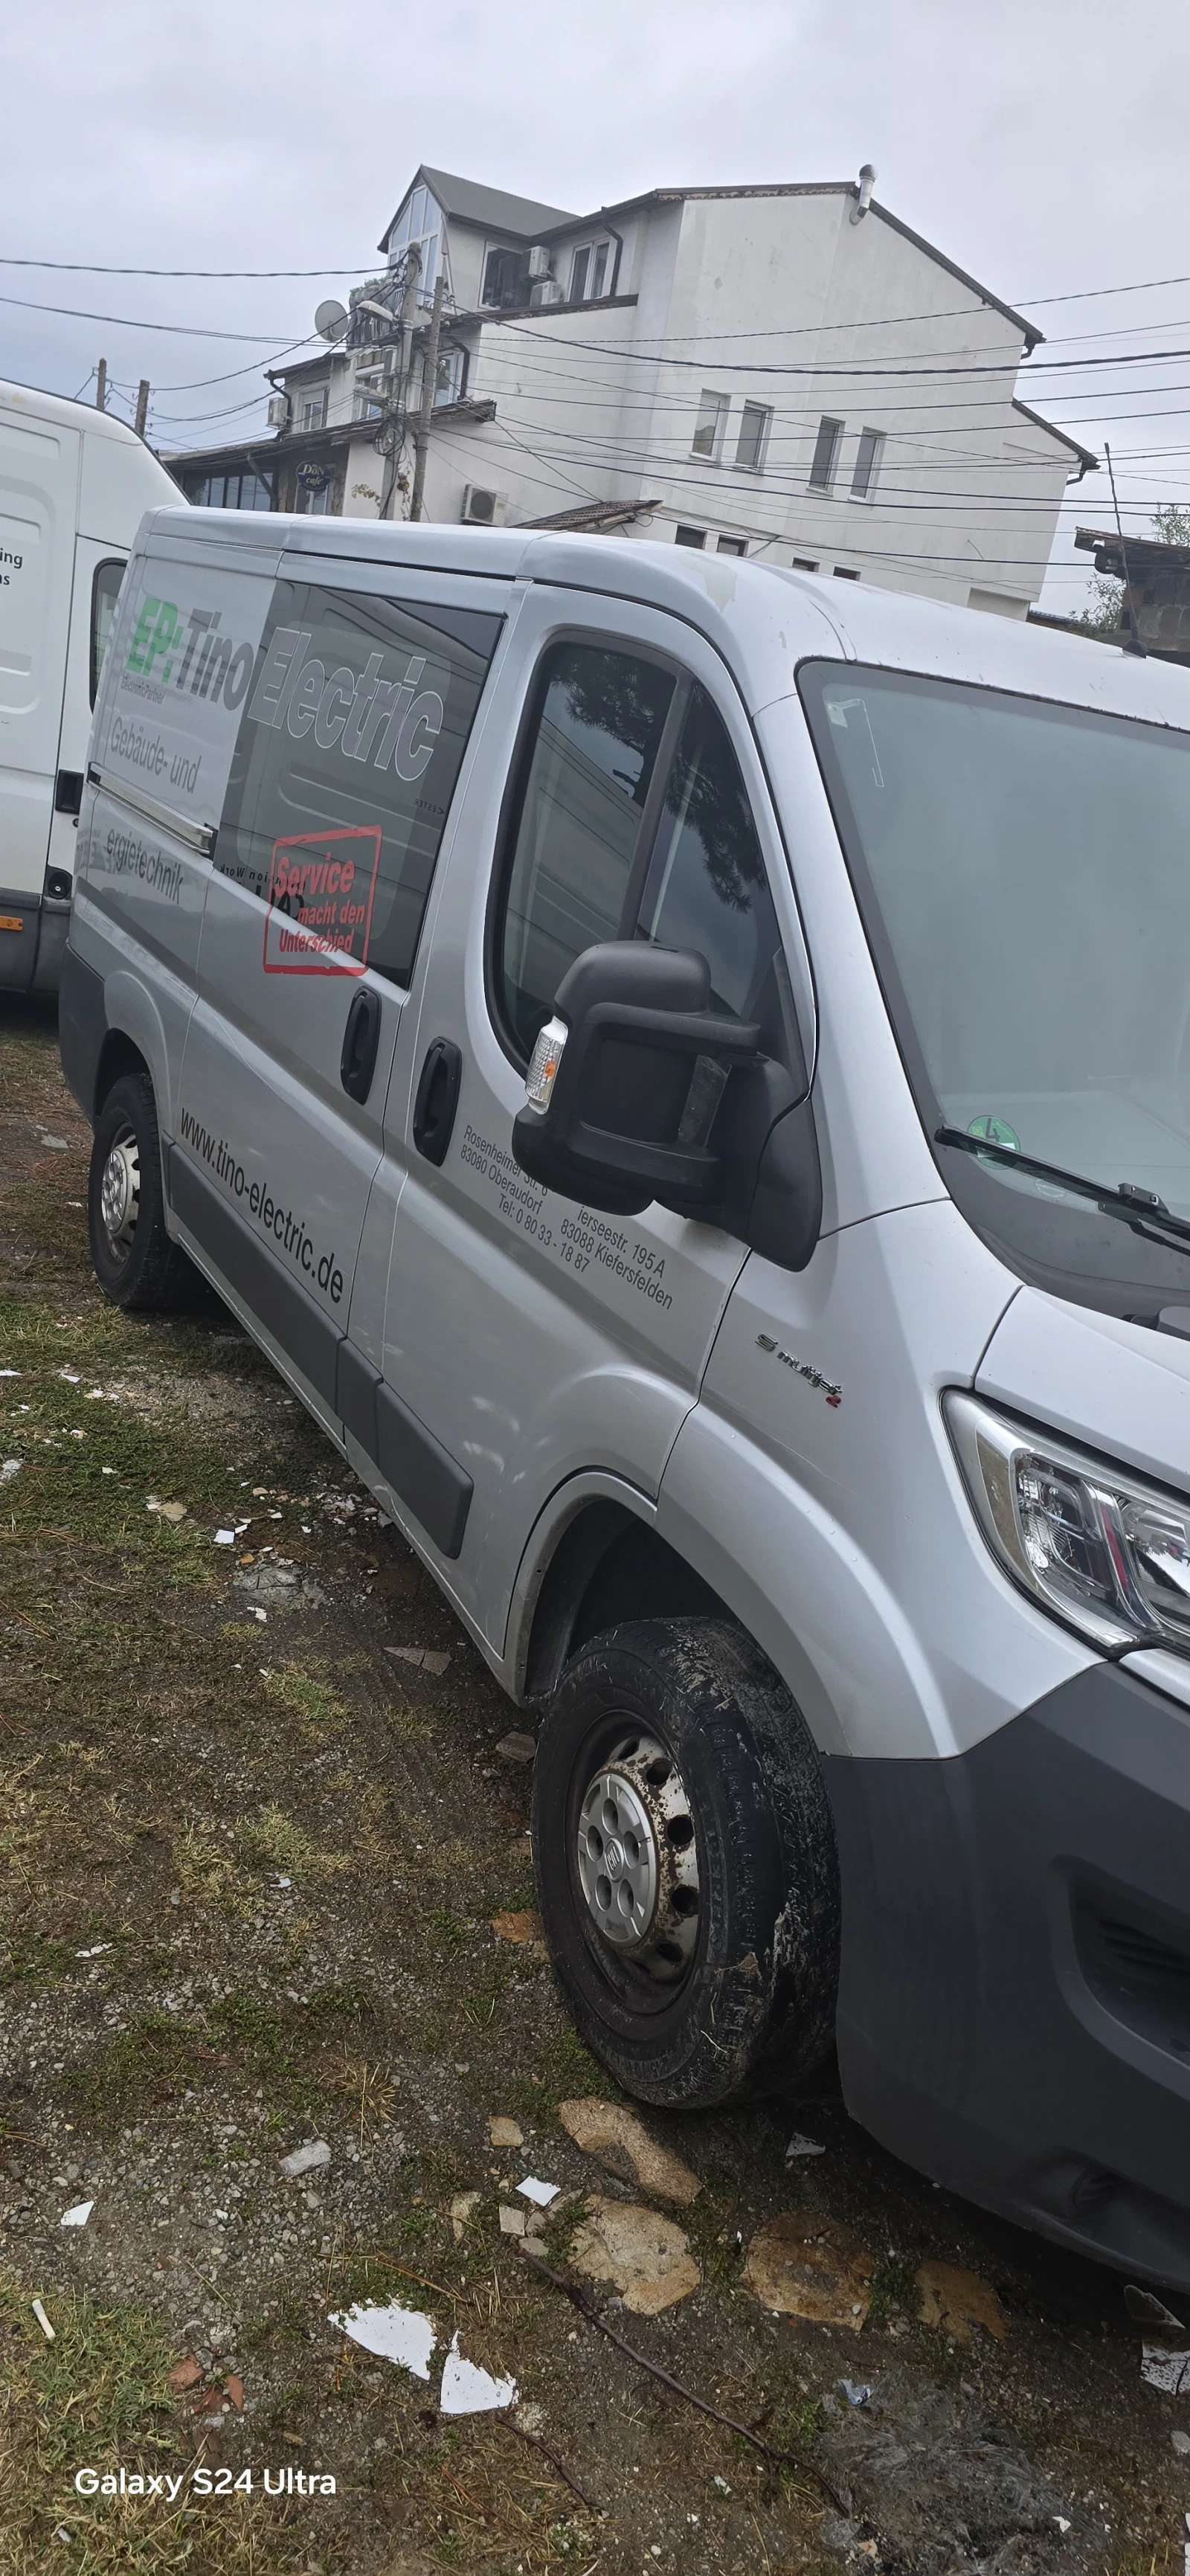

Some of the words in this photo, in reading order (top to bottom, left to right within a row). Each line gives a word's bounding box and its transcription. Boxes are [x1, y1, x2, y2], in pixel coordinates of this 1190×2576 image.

[247, 626, 444, 781] Electric
[110, 716, 168, 776] Gebäude-
[170, 755, 202, 794] und
[107, 828, 184, 905] ergietechnik
[274, 852, 356, 898] Service
[279, 928, 355, 954] Unterschied
[298, 900, 338, 926] macht
[340, 899, 366, 925] den
[463, 1125, 522, 1178] Rosenheimer
[985, 1117, 1001, 1143] 4
[180, 1107, 344, 1304] www.tino-electric.de
[460, 1144, 488, 1174] 83080
[488, 1164, 544, 1215] Oberaudorf
[499, 1192, 515, 1218] Tel:
[515, 1208, 524, 1224] 0
[524, 1215, 538, 1234] 80
[538, 1224, 552, 1246] 33
[560, 1242, 573, 1262] 18
[574, 1253, 591, 1273] 87
[560, 1218, 595, 1253] 83088
[594, 1242, 673, 1310] Kiefersfelden
